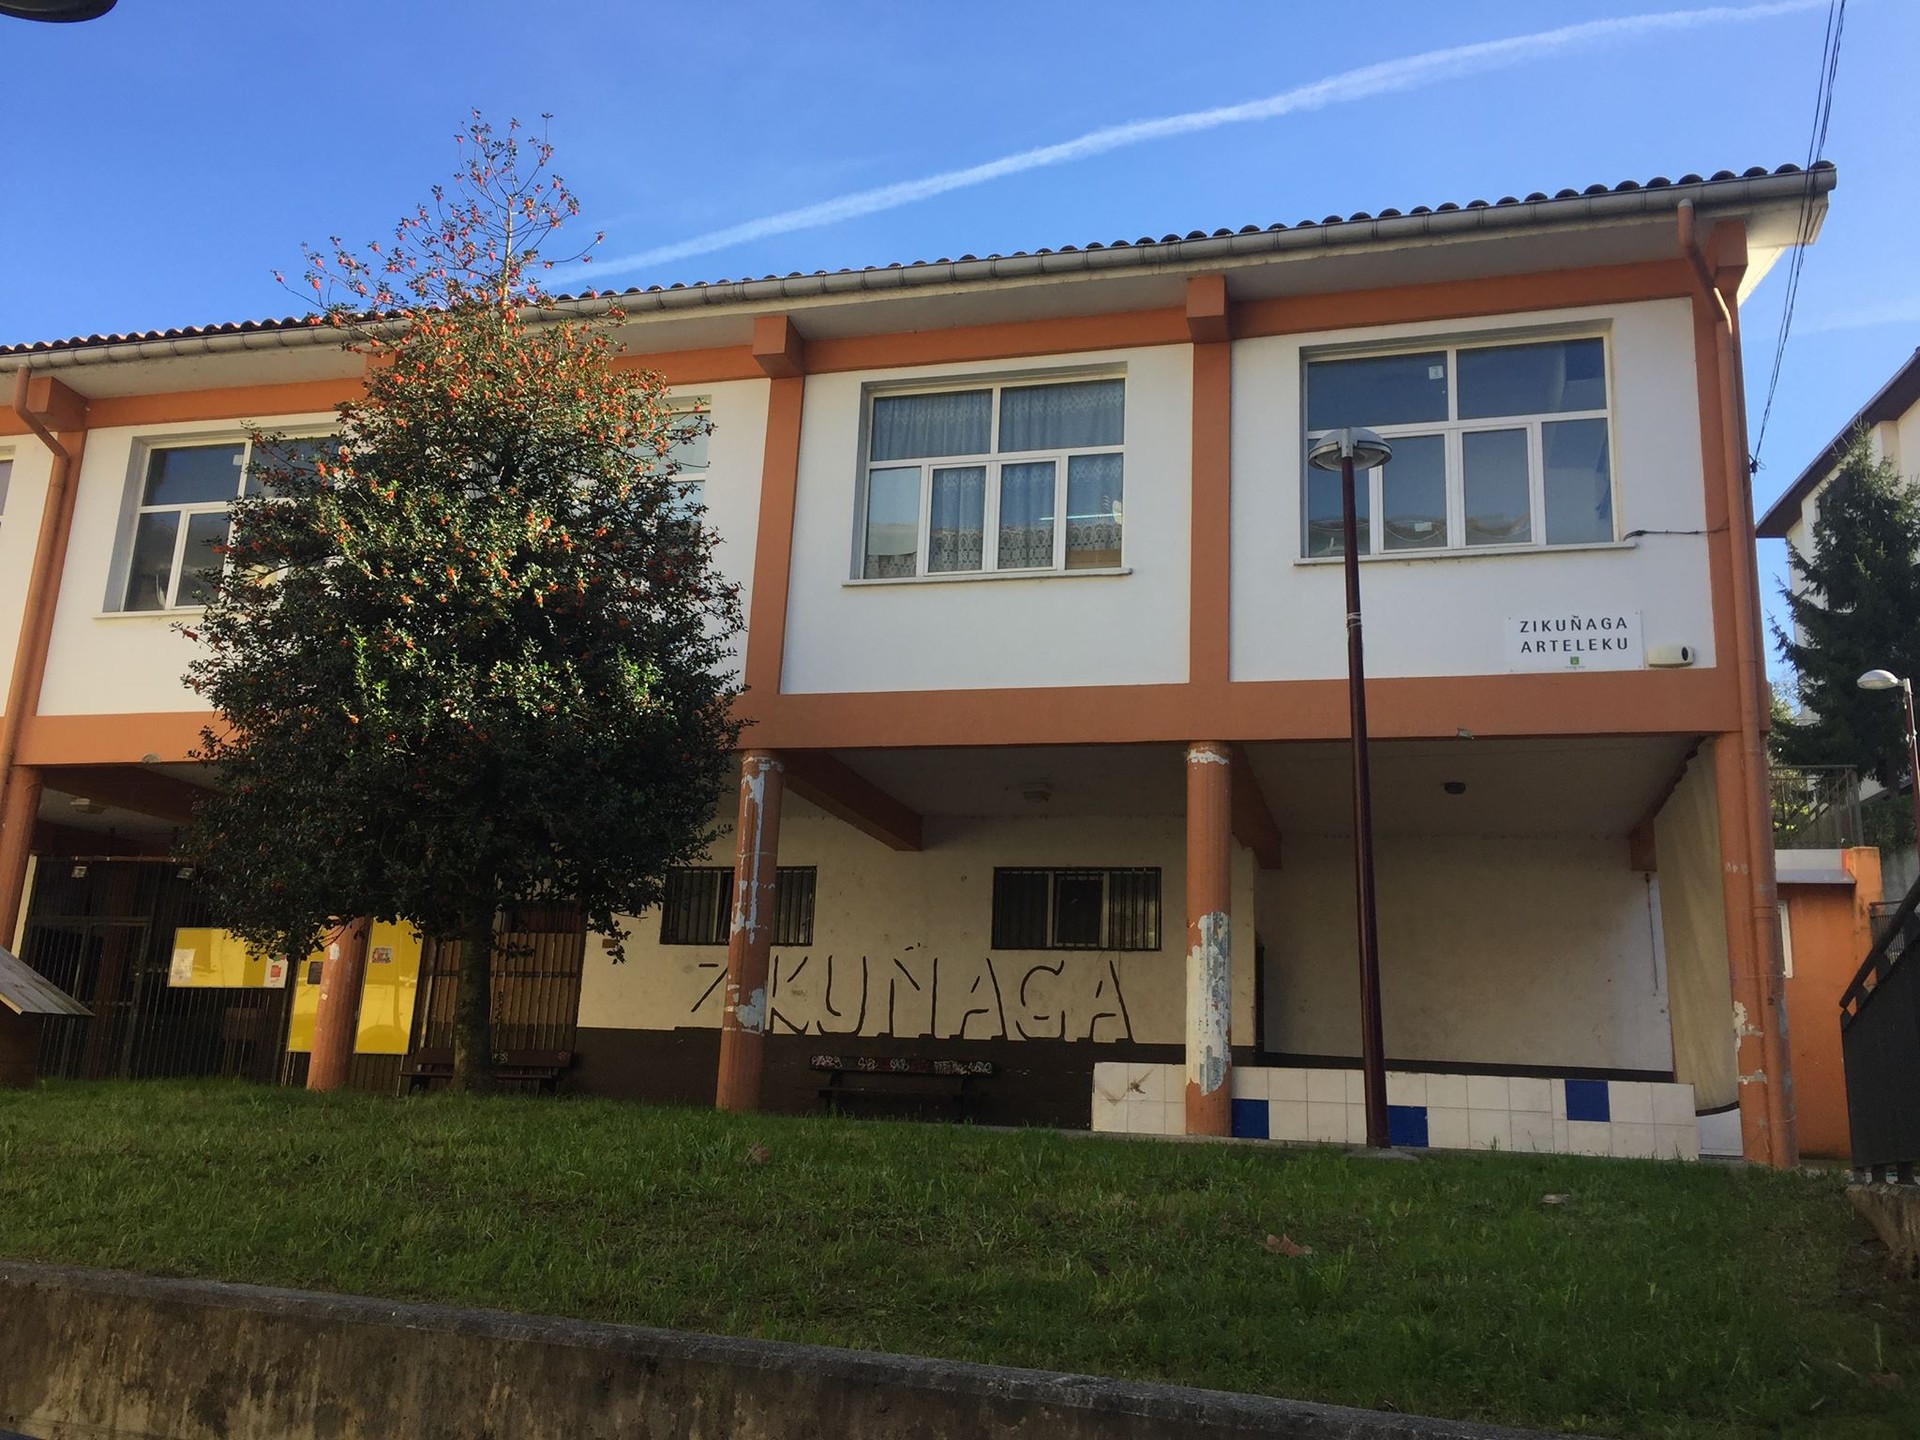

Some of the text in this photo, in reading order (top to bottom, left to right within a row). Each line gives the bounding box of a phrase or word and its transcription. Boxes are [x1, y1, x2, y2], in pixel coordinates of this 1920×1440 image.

[1519, 614, 1628, 633] ZIKUÑAGA
[1520, 637, 1629, 653] ARTELEKU
[690, 942, 1136, 1044] ZKUÑAGA
